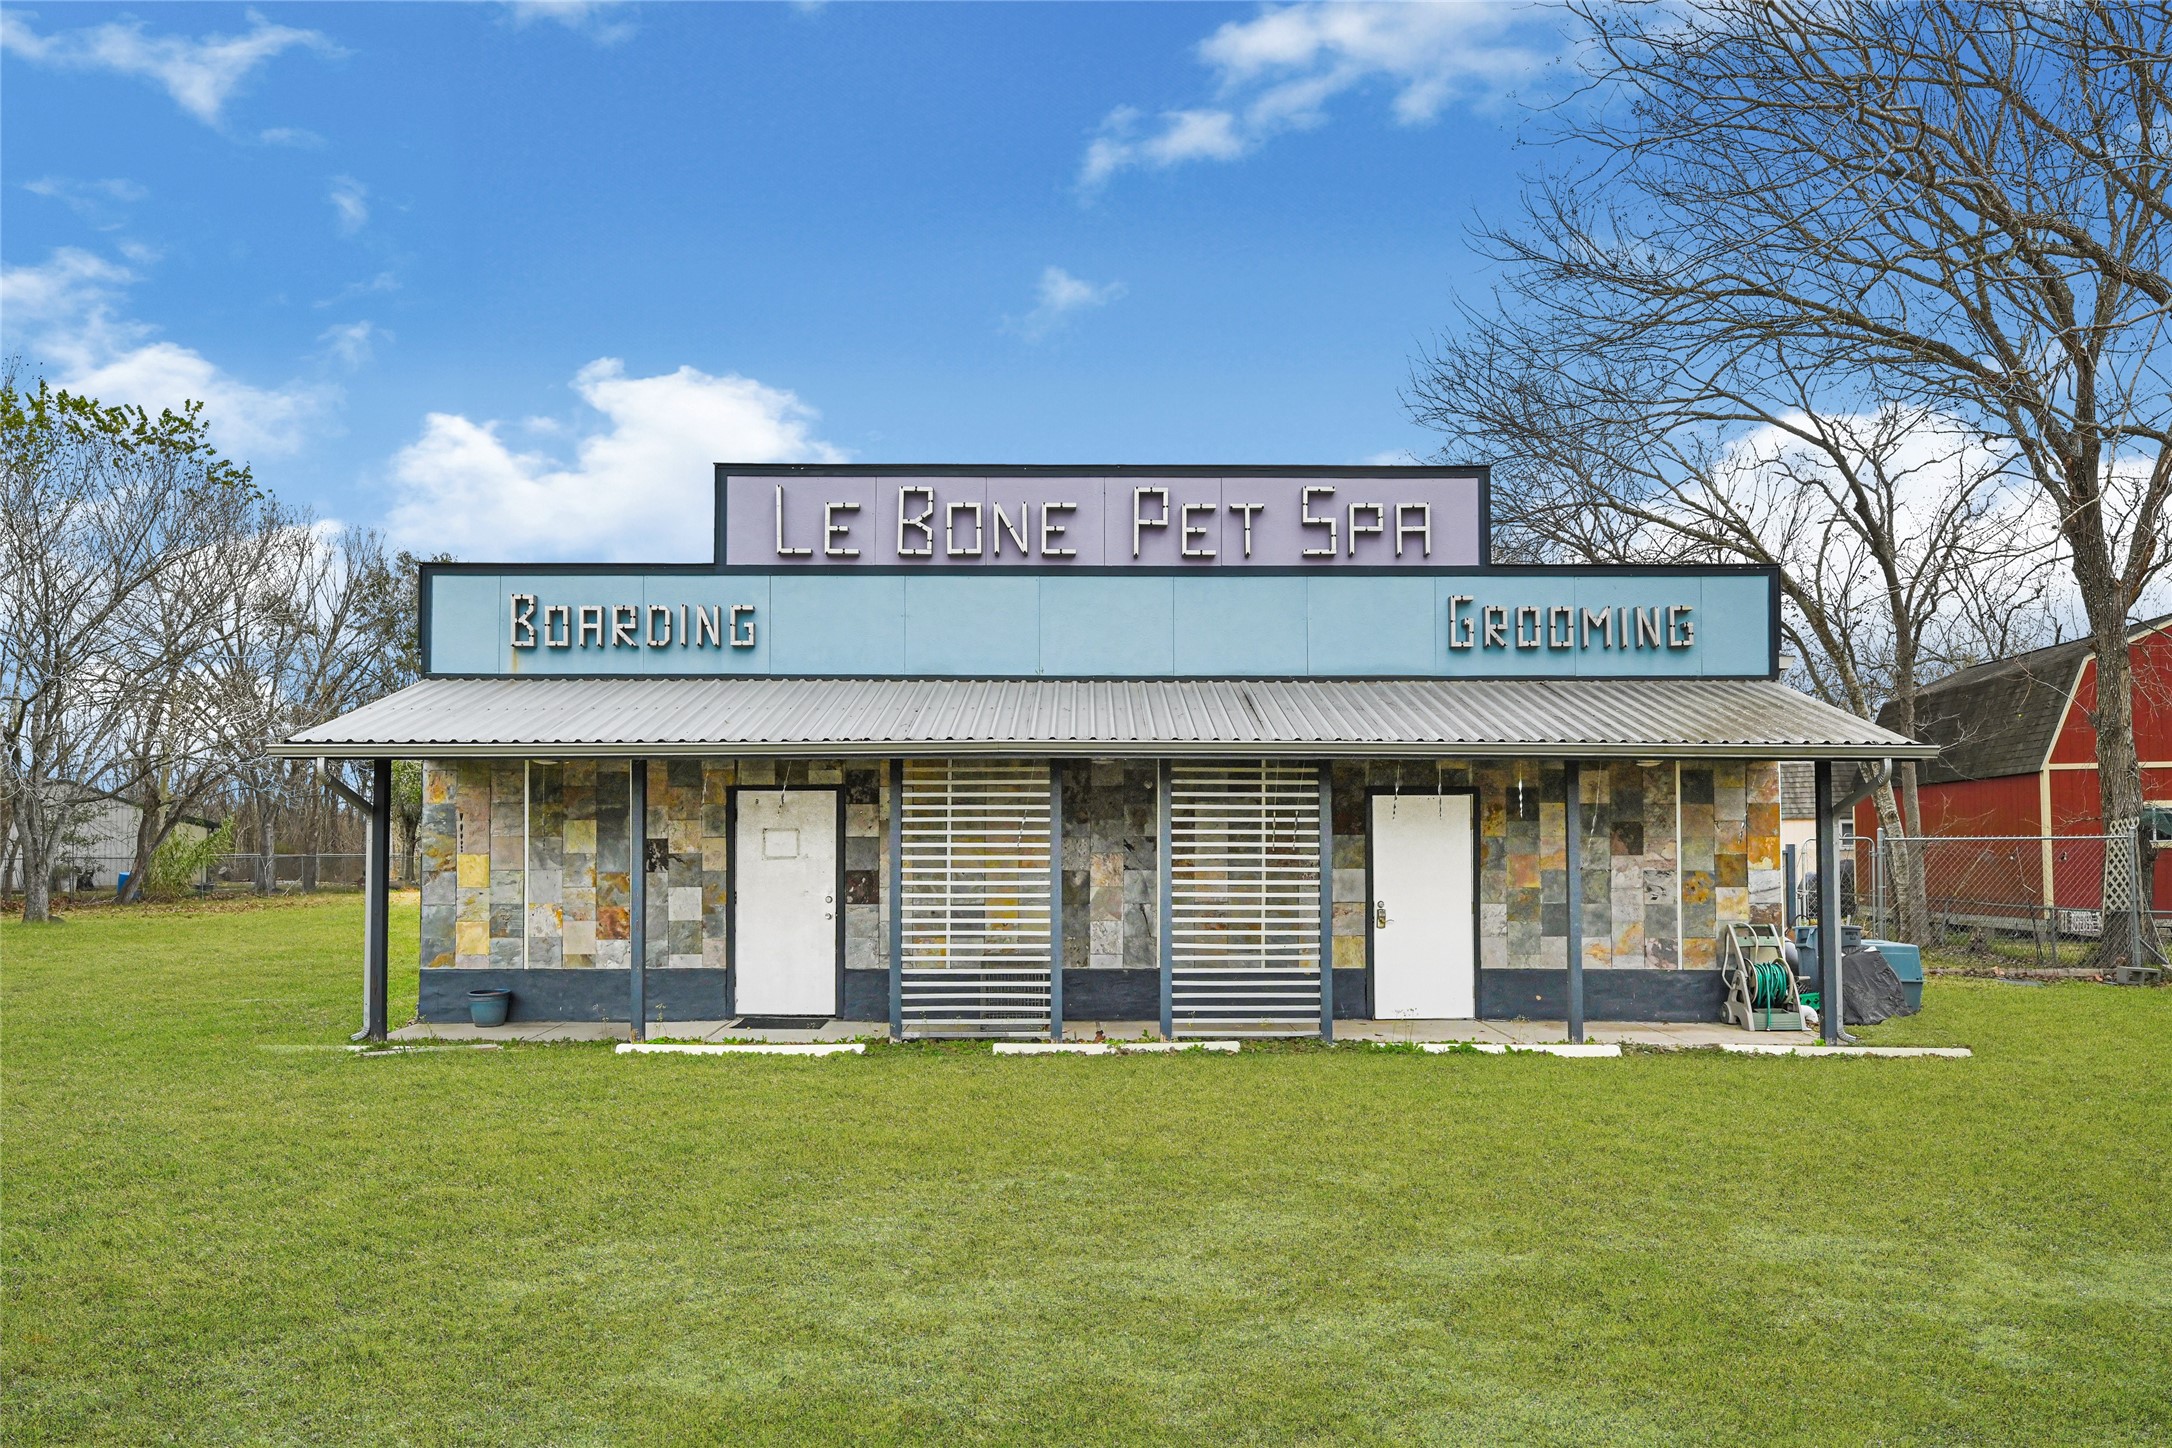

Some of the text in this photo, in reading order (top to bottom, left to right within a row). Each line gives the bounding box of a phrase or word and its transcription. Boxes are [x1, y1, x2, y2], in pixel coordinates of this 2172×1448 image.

[776, 485, 1431, 558] LE BONE PET SPA
[510, 593, 756, 648] BOARDING
[1448, 595, 1694, 649] GROOMING
